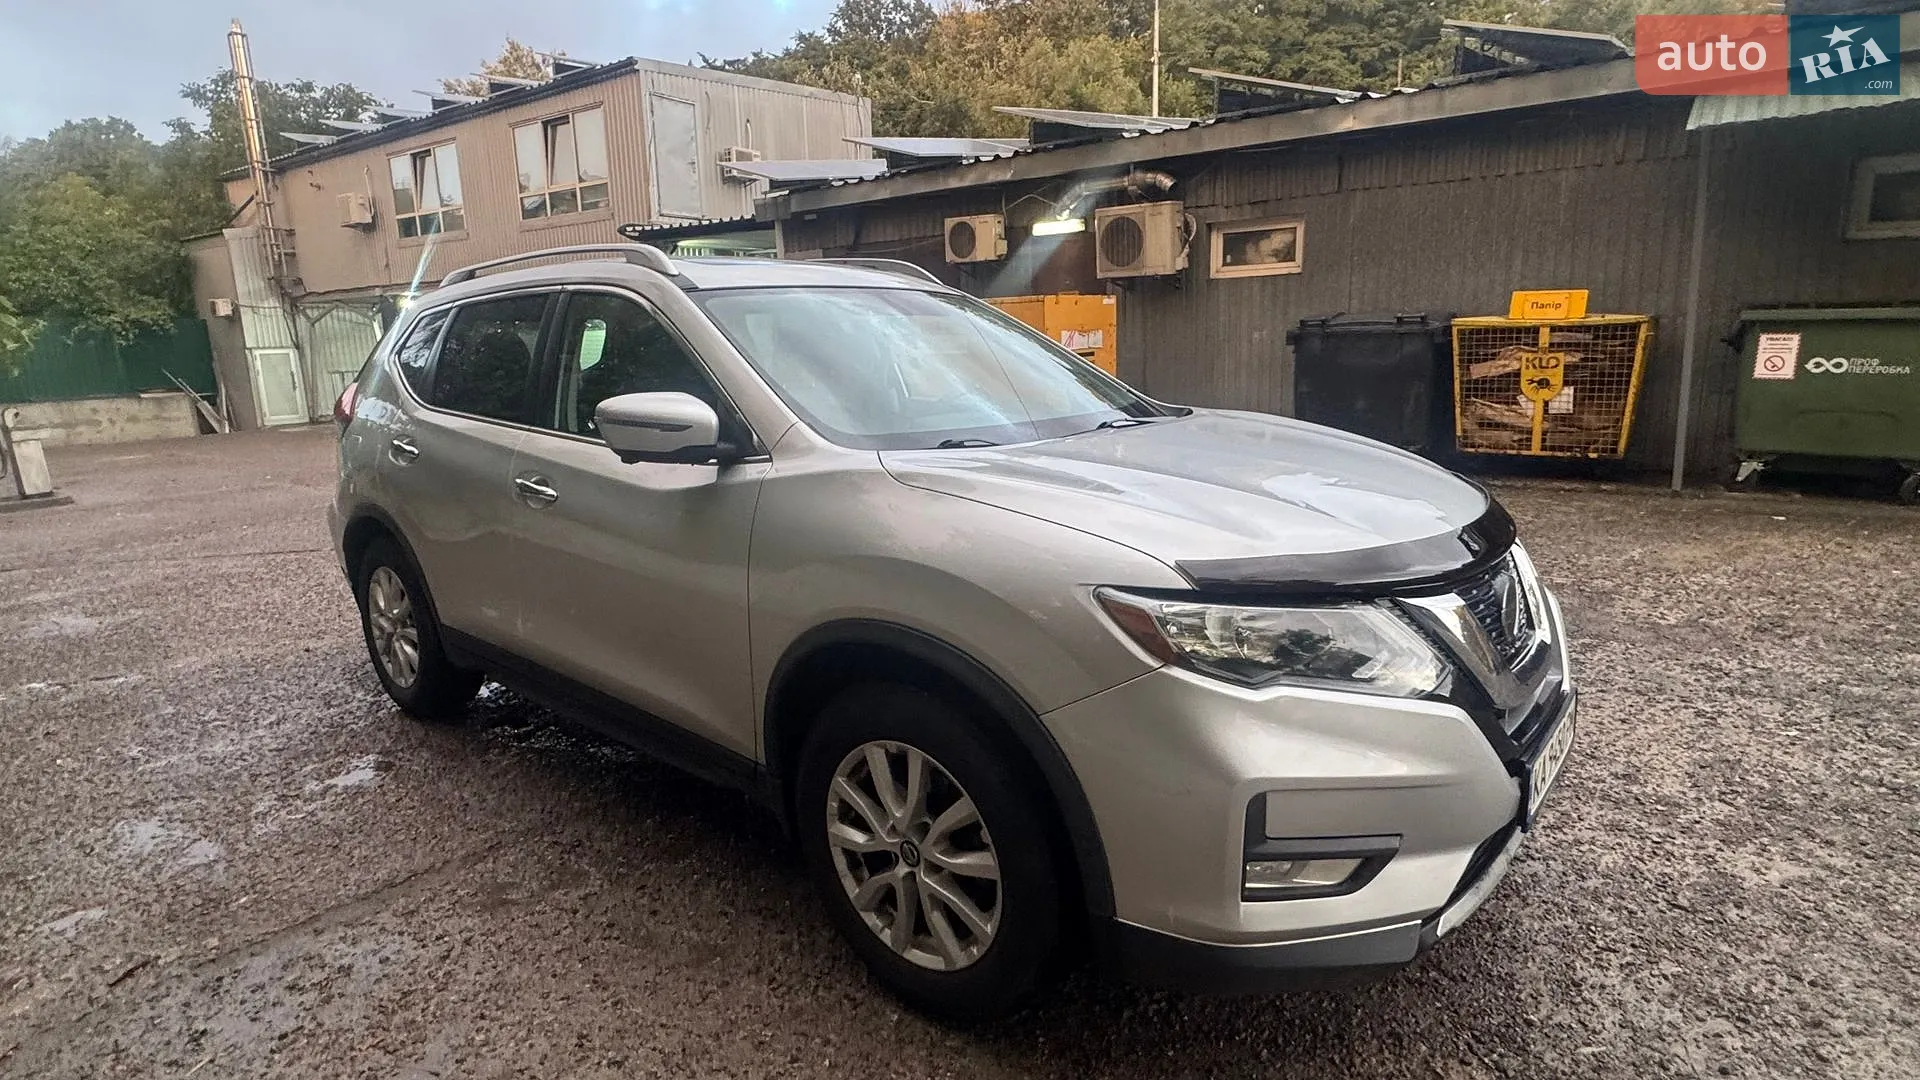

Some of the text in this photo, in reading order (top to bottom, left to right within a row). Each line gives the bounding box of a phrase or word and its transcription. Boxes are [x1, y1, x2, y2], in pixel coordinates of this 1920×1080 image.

[1530, 301, 1562, 311] Папір
[1525, 356, 1560, 370] KLO
[1849, 358, 1880, 366] ПРОФ
[1848, 365, 1910, 375] ПЕРЕРОБКА
